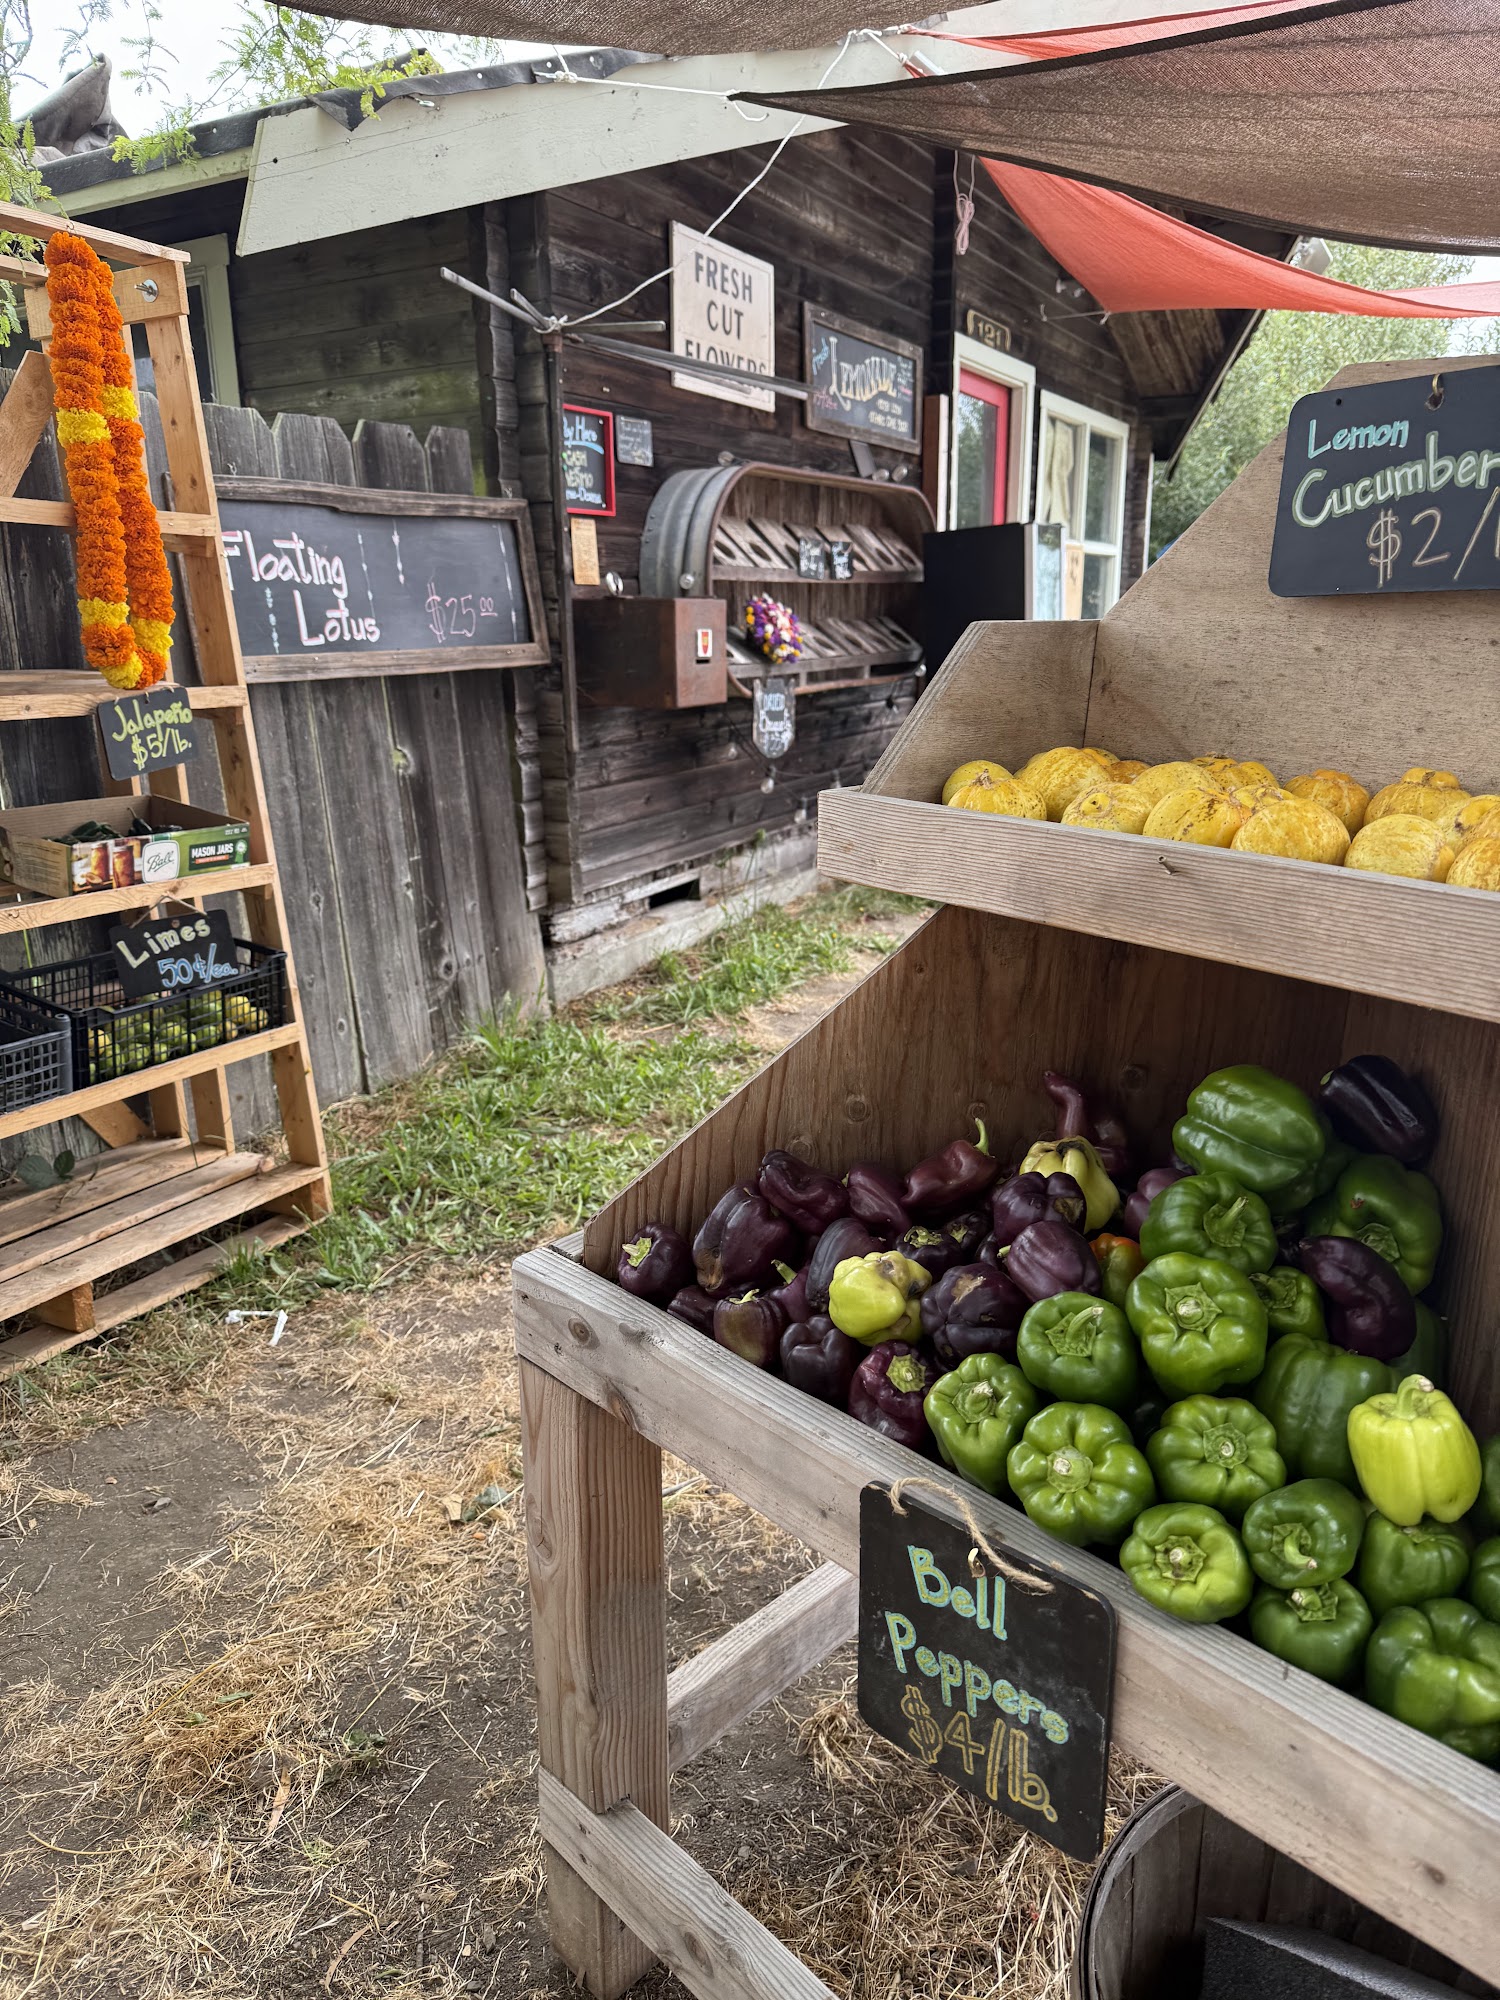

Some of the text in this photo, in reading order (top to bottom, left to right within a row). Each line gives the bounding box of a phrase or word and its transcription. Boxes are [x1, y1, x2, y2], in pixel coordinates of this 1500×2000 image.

[694, 251, 753, 304] FRESH
[706, 298, 745, 341] CUT
[977, 319, 1001, 347] 121
[1307, 418, 1410, 459] Lemon
[221, 530, 348, 599] Floating
[293, 589, 381, 646] Lotus
[111, 698, 193, 742] Jalapeño
[131, 727, 192, 771] $5/lb.
[147, 851, 175, 873] Ball
[191, 843, 234, 858] MASON JARS
[116, 919, 211, 969] Limes
[907, 1545, 1008, 1641] Bell
[885, 1611, 1069, 1745] Peppers
[900, 1684, 1059, 1824] $4/lb.
